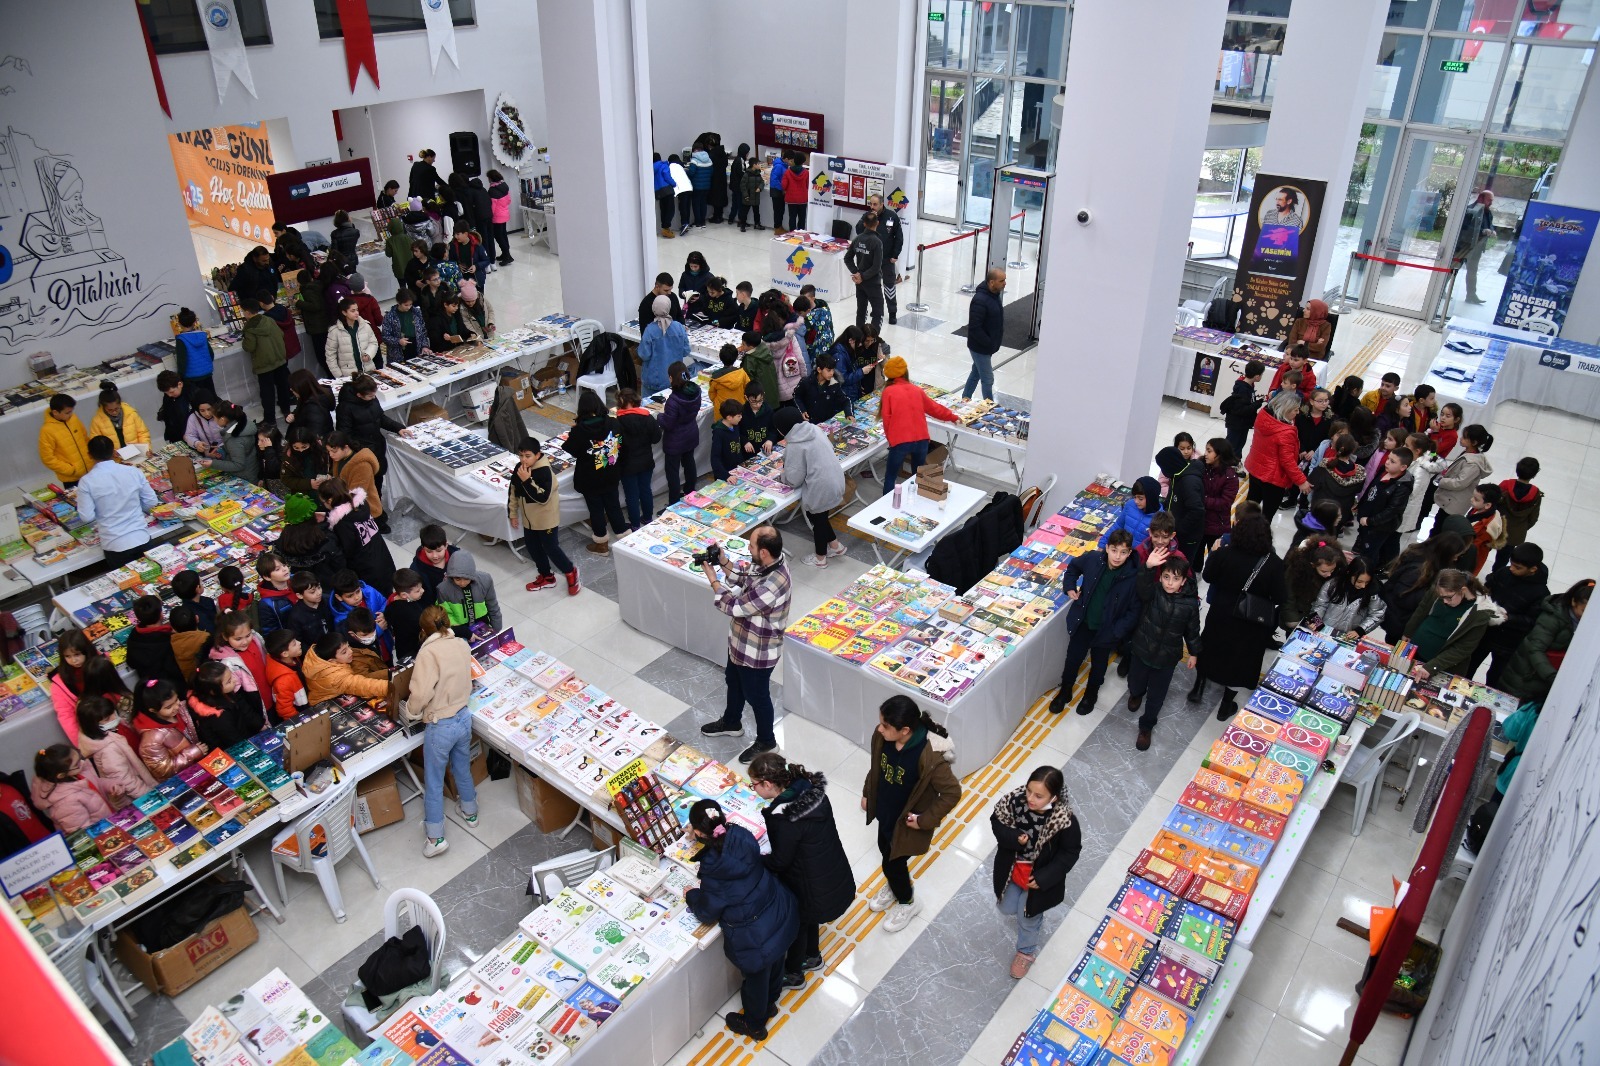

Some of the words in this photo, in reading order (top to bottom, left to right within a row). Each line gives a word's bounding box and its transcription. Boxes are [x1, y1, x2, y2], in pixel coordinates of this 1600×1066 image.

[47, 270, 142, 310] Ortahisar
[1511, 292, 1557, 310] MACERA
[3, 857, 40, 881] KLASİKLERİ
[41, 852, 51, 860] 20
[50, 848, 59, 856] TL
[15, 849, 39, 866] ÇOCUK
[31, 859, 55, 875] HEDİYE
[556, 895, 573, 909] tam
[1138, 999, 1163, 1029] TOST
